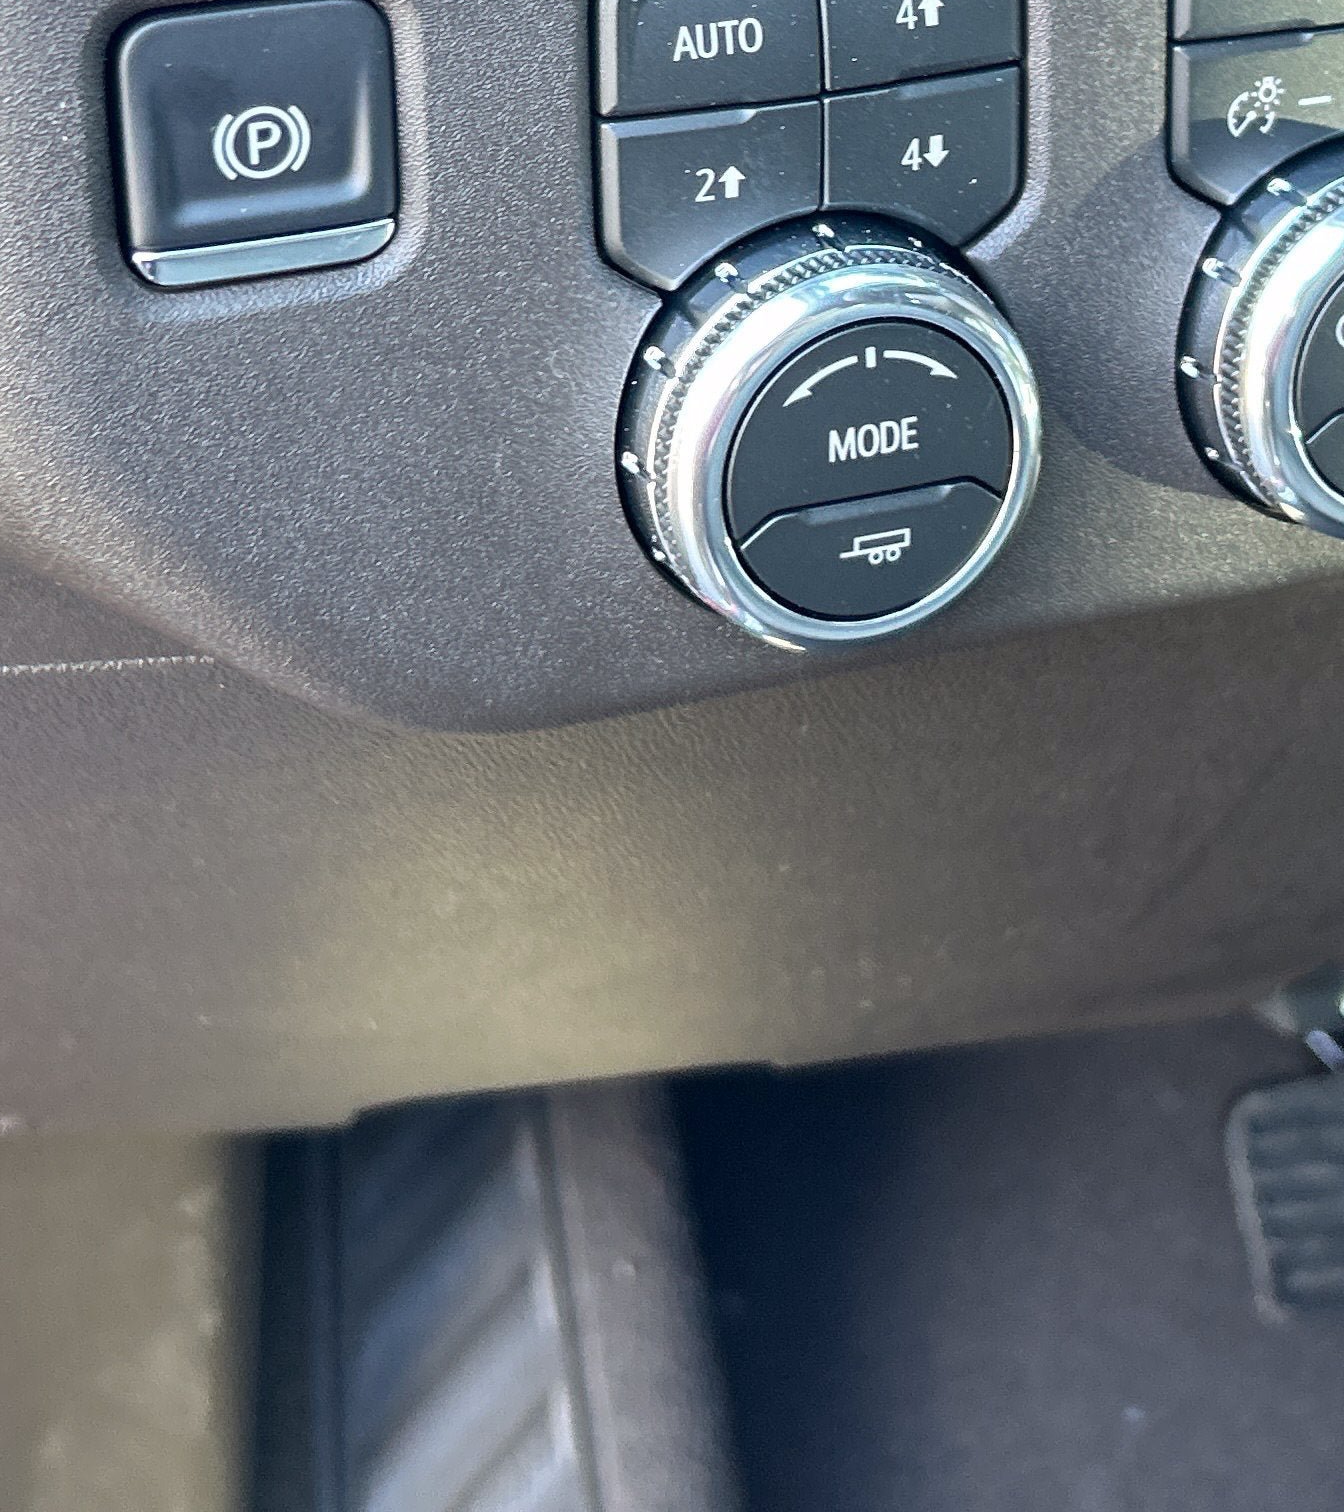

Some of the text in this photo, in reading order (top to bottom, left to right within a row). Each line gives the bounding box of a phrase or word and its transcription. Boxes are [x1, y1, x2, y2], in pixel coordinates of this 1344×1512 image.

[673, 17, 763, 62] AUTO
[247, 120, 282, 165] P
[828, 416, 920, 463] MODE
